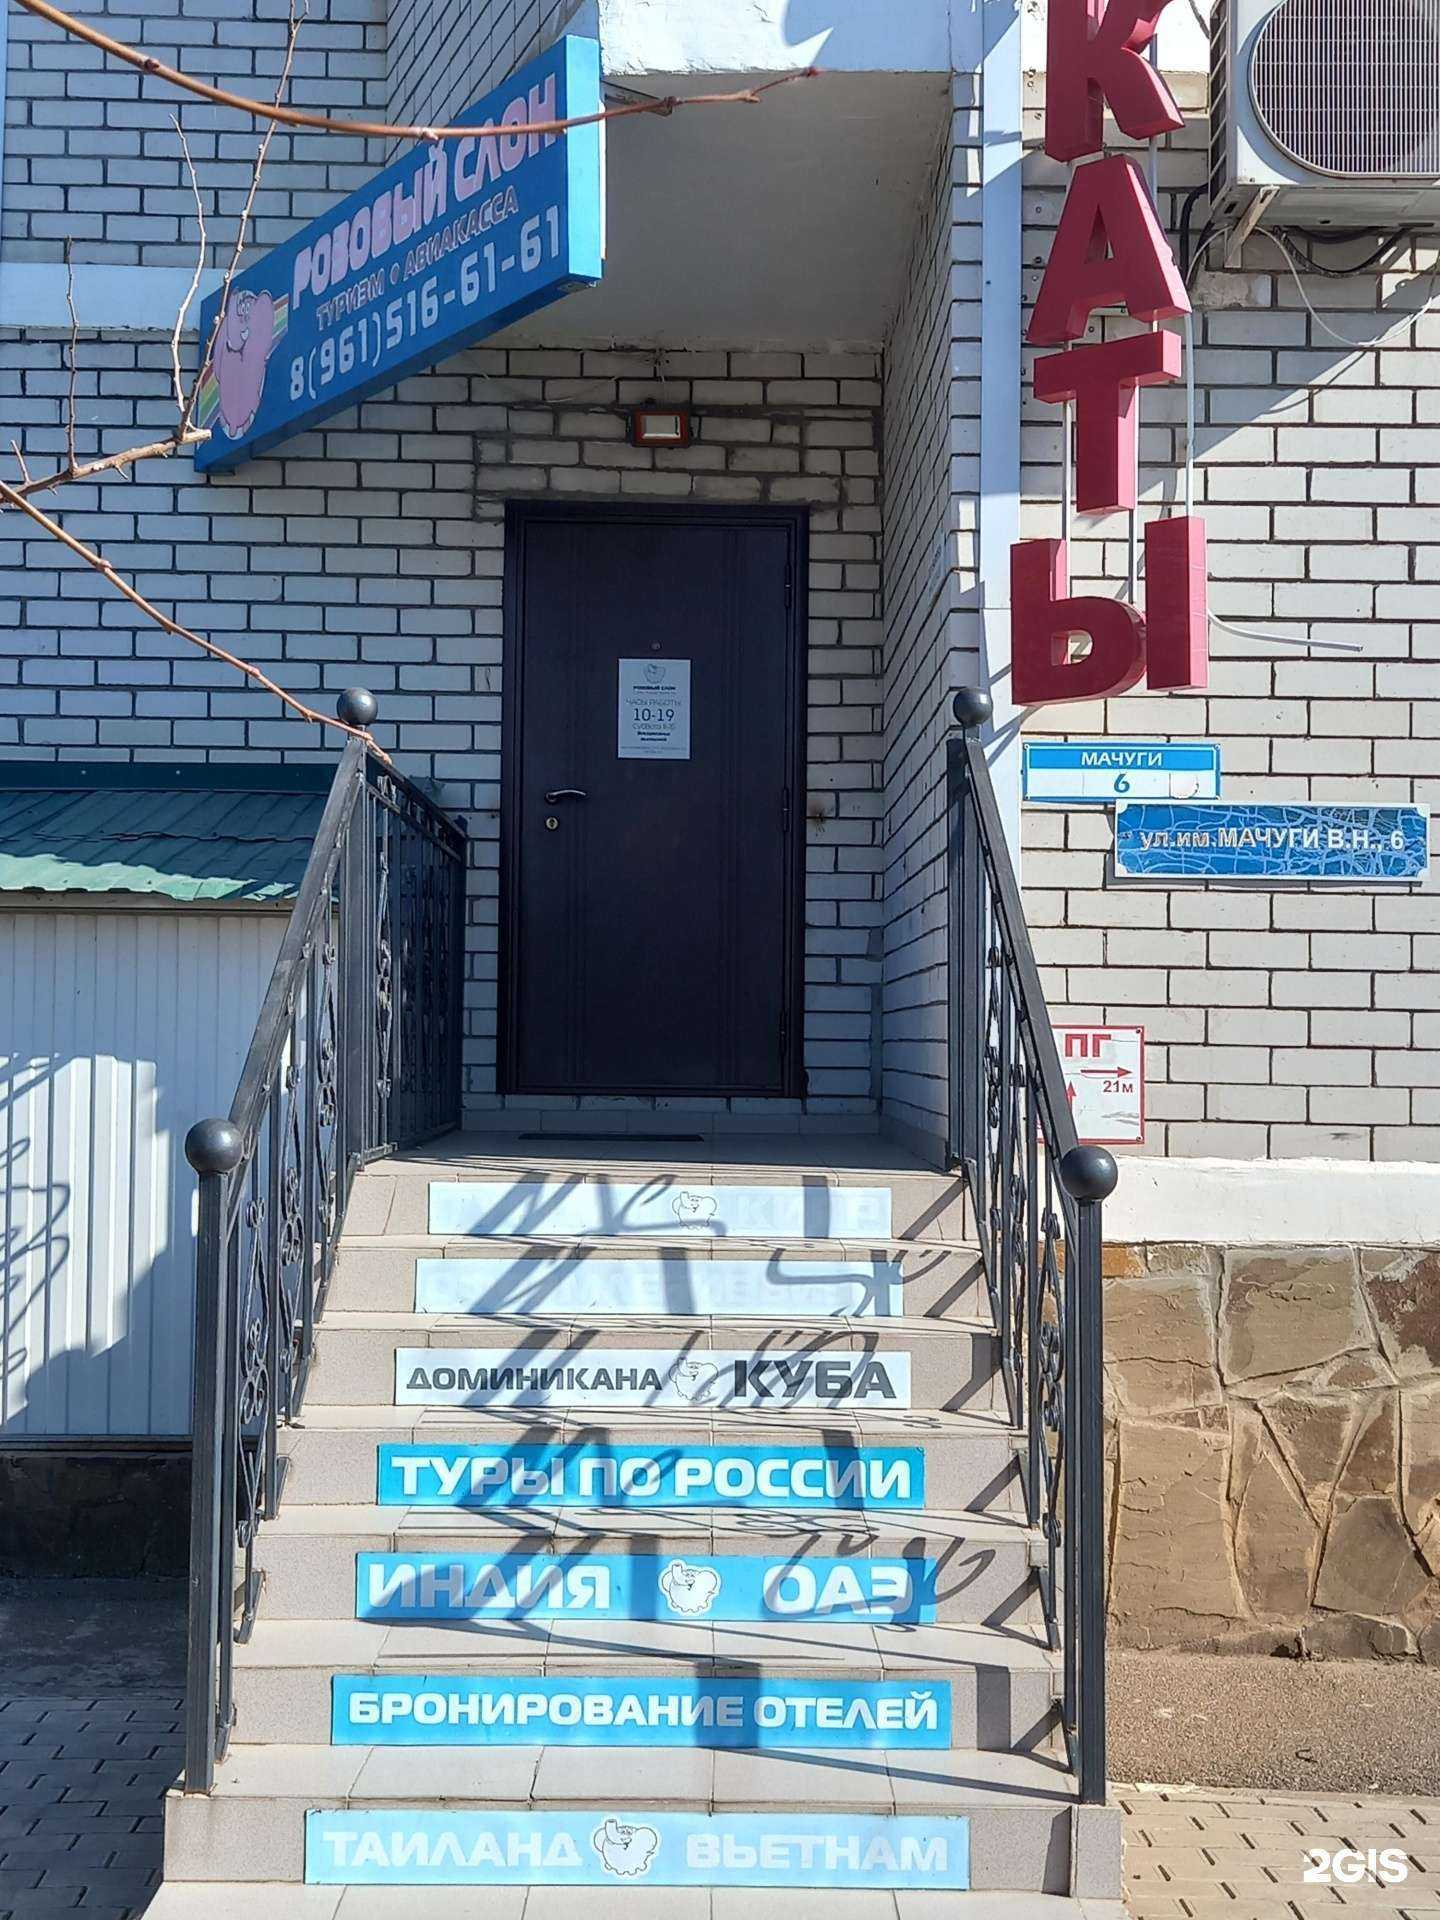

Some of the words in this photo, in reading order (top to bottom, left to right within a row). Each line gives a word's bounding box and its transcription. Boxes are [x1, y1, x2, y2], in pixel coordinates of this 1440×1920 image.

[292, 140, 448, 310] РОЗОВЫЙ
[454, 73, 556, 202] СЛОН
[315, 267, 385, 332] ТУРИЗМ
[402, 184, 519, 282] АВИАКАССА
[633, 708, 675, 722] 10-19
[1081, 751, 1163, 767] МАЧУГИ
[1113, 773, 1131, 794] 6
[1390, 830, 1405, 850] 6
[1065, 1033, 1112, 1057] ПГ
[406, 1366, 663, 1391] ДОМИНИКАНА
[733, 1359, 897, 1399] КУБА
[391, 1456, 563, 1497] ТУРЫ
[580, 1457, 667, 1497] ПО
[673, 1457, 911, 1498] РОССИИ
[368, 1563, 611, 1609] ИНДИЯ
[763, 1565, 913, 1614] ОАЭ
[349, 1691, 744, 1727] БРОНИРОВАНИЕ
[753, 1691, 938, 1729] ОТЕЛЕЙ
[323, 1831, 583, 1867] ТАИЛАНД
[685, 1834, 949, 1871] ВЬЕТНАМ
